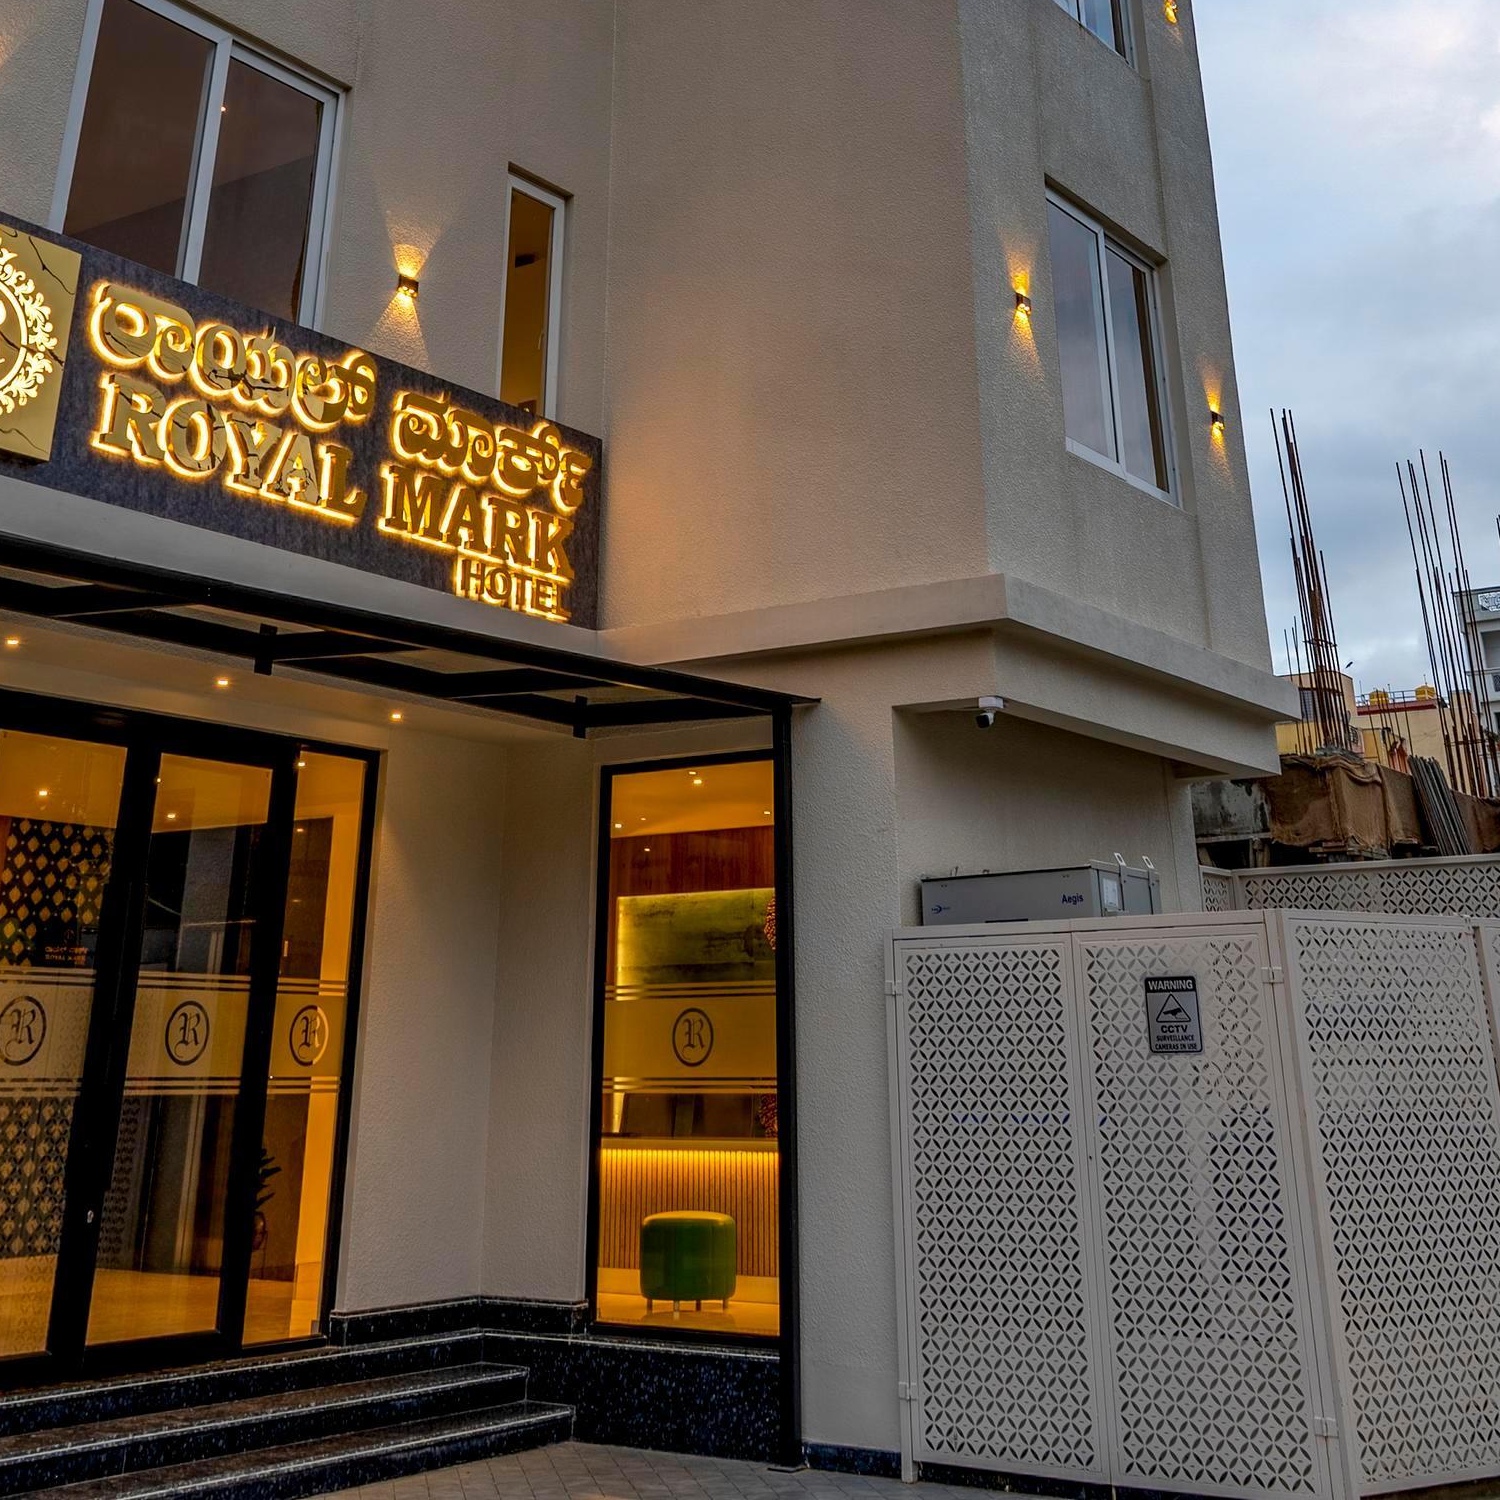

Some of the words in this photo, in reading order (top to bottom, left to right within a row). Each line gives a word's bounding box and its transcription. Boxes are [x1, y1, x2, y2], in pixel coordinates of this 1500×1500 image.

[91, 281, 377, 431] ರಾಯಲ್
[92, 371, 367, 522] ROYAL
[377, 462, 575, 582] MARK
[455, 556, 571, 621] HOTEL
[1061, 893, 1084, 906] Aegis
[1148, 980, 1193, 991] WARNING
[1161, 1025, 1188, 1033] CCTV
[1156, 1034, 1194, 1042] SURVEILLANCE
